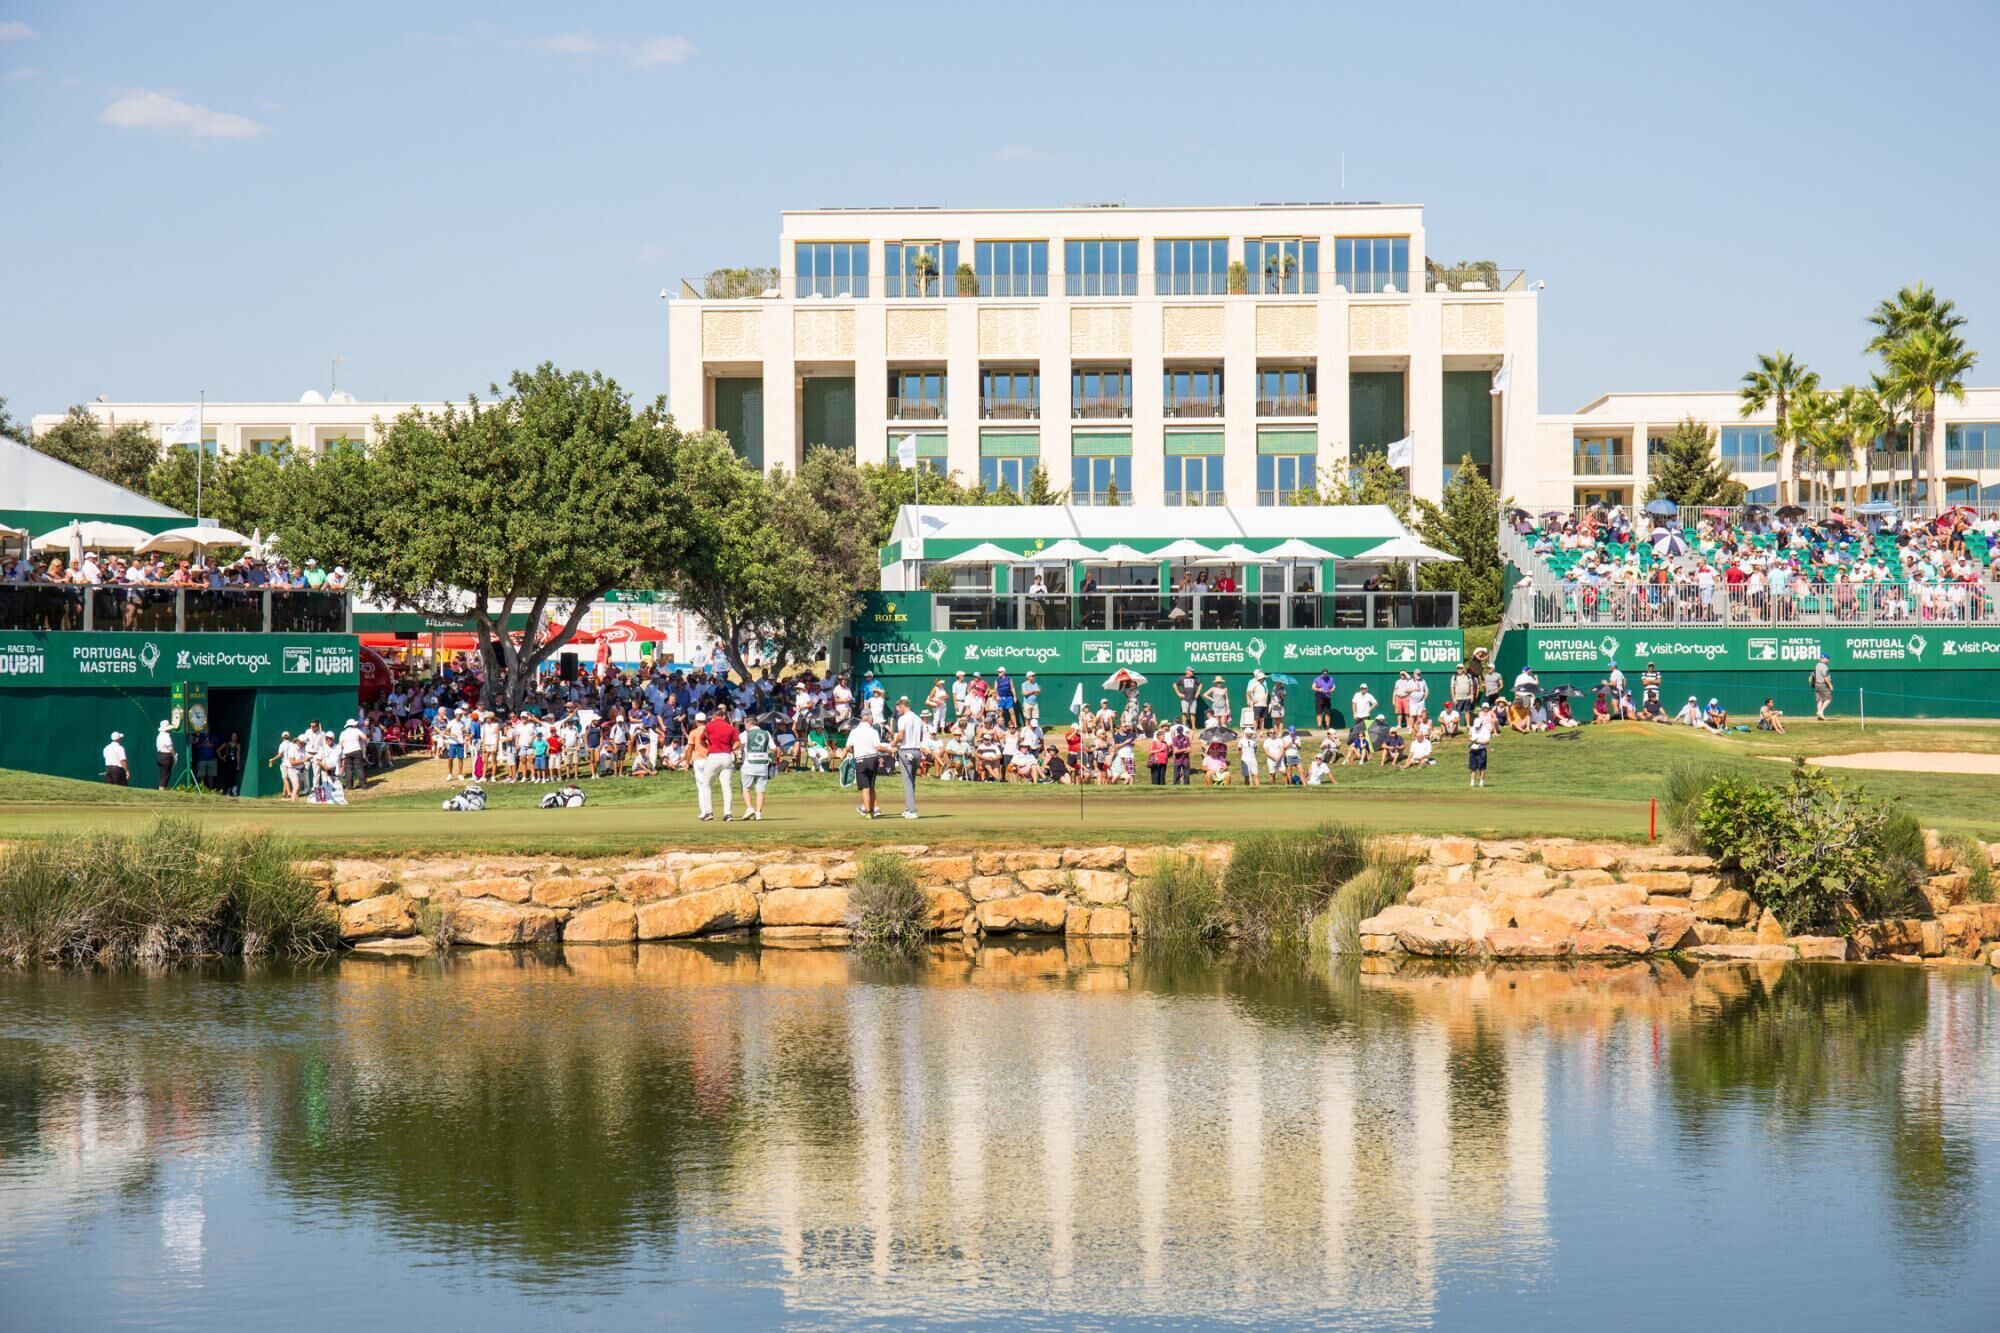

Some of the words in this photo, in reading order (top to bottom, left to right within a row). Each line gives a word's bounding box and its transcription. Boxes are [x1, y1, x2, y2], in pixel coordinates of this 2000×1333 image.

[875, 613, 908, 622] ROLEX
[863, 643, 923, 653] PORTUGAL
[1184, 642, 1243, 651] PORTUGAL
[1538, 640, 1597, 650] PORTUGAL
[1846, 638, 1905, 648] PORTUGAL
[1957, 642, 1981, 653] visit
[8, 645, 24, 653] RACE
[26, 645, 35, 653] TO
[73, 647, 136, 659] PORTUGAL
[980, 647, 1003, 657] visit
[1005, 646, 1061, 663] Portugal
[1299, 646, 1322, 656] visit
[1323, 644, 1378, 662] Portugal
[1650, 643, 1673, 654] visit
[1674, 643, 1728, 661] Portugal
[1781, 645, 1820, 662] DUBAI
[1852, 649, 1905, 659] MASTERS
[869, 654, 924, 663] MASTERS
[1116, 648, 1157, 665] DUBAI
[1190, 653, 1244, 662] MASTERS
[1420, 647, 1460, 664] DUBAI
[1544, 651, 1598, 661] MASTERS
[0, 655, 44, 676] DUBAI
[80, 661, 137, 673] MASTERS
[192, 652, 214, 666] visit
[216, 652, 271, 672] Portugal
[315, 656, 353, 675] DUBAI
